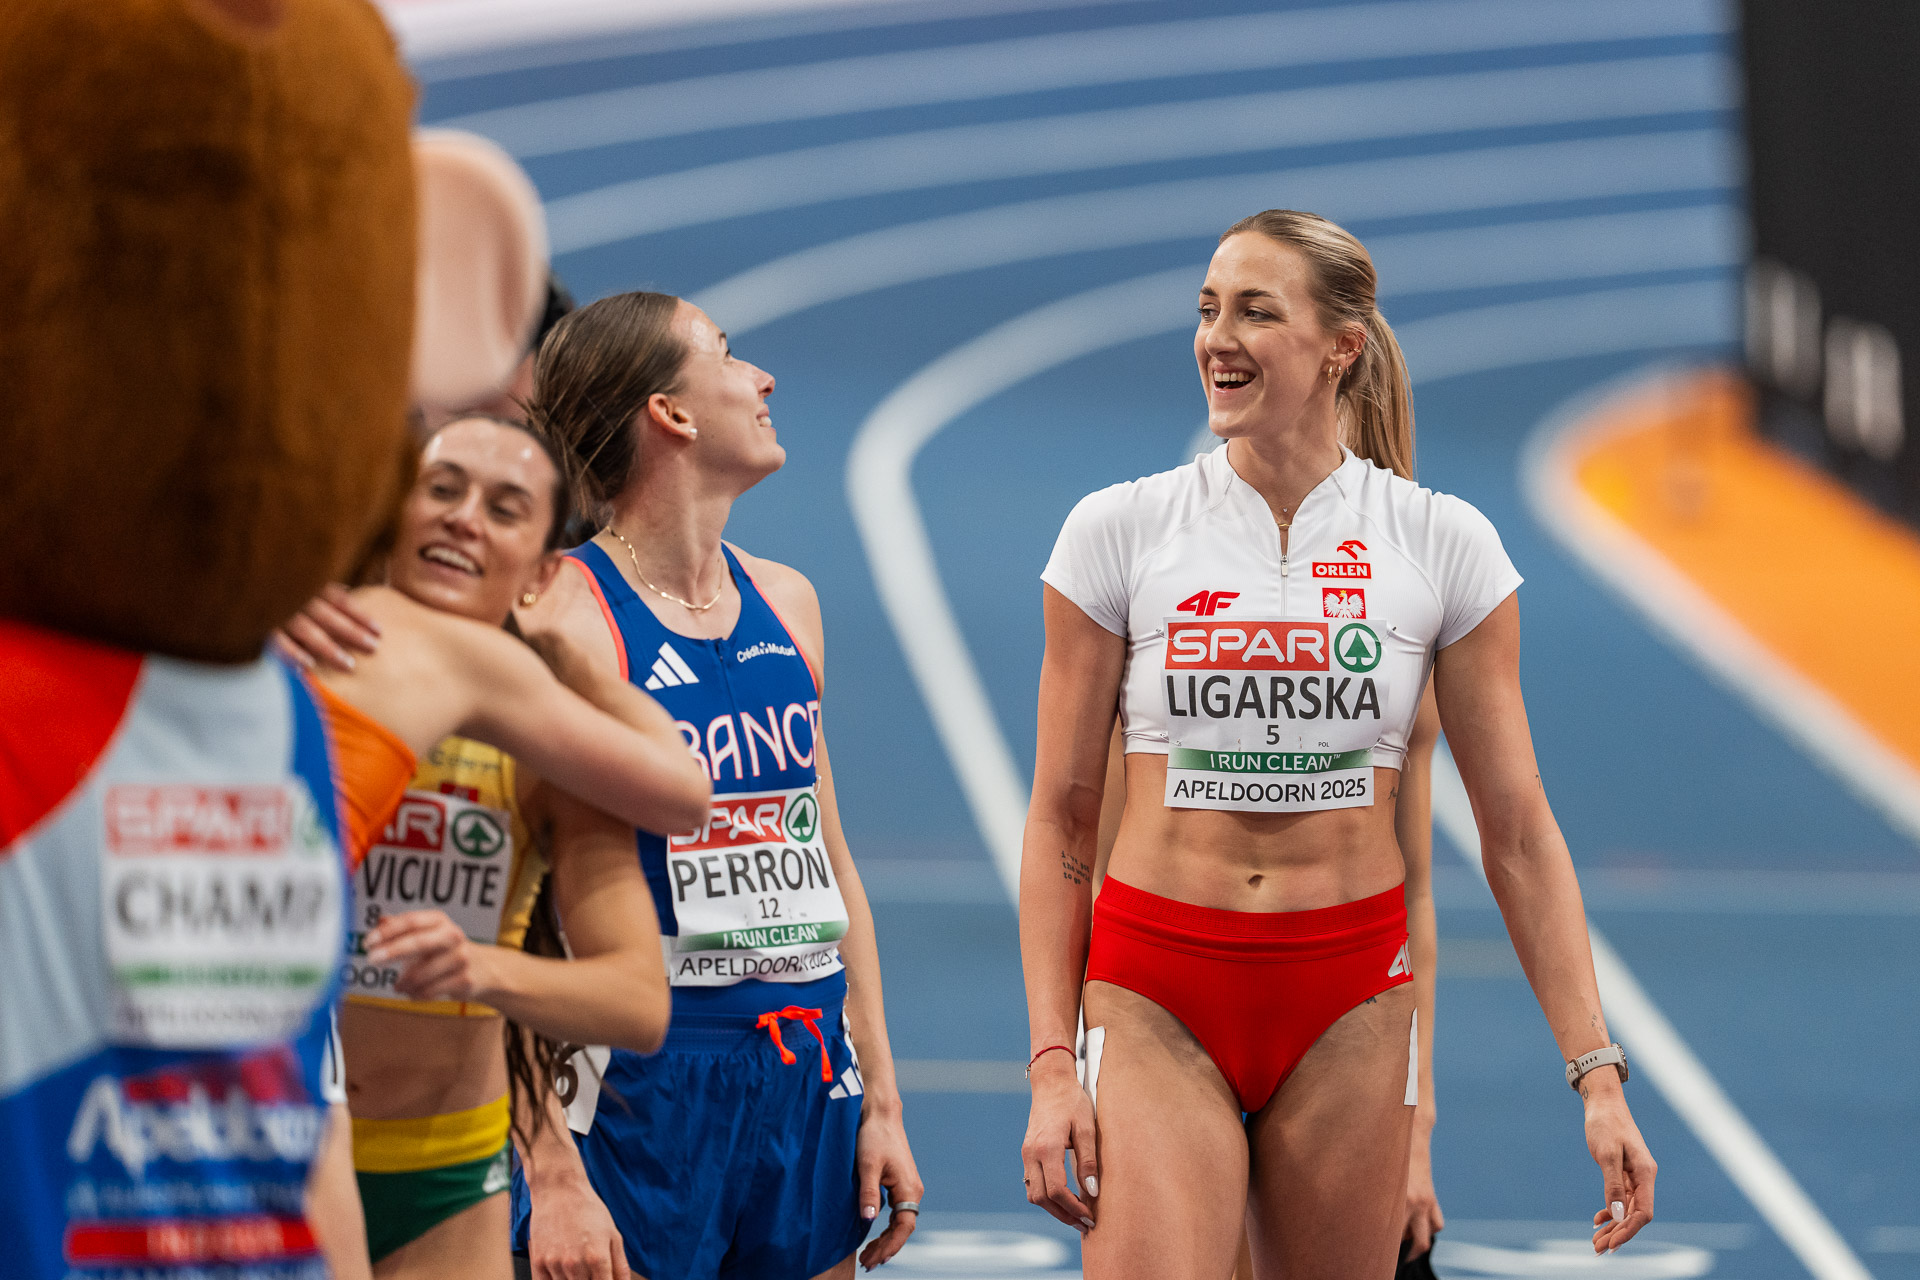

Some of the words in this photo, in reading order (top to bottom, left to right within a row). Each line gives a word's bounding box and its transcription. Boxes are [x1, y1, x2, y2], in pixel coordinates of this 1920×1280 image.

[1315, 564, 1368, 577] ORLEN
[1177, 590, 1241, 616] 4F
[1171, 628, 1325, 664] SPAR
[1167, 675, 1381, 720] LIGARSKA
[674, 700, 819, 781] RANC
[1265, 725, 1280, 745] 5
[1209, 753, 1215, 770] I
[1218, 753, 1261, 771] RUN
[1174, 779, 1316, 803] APELDOORN
[1320, 777, 1366, 800] 2025
[354, 853, 501, 908] VICIUTE
[672, 847, 830, 902] PERRON
[758, 897, 781, 919] 12
[723, 934, 728, 948] I
[732, 930, 768, 947] RUN
